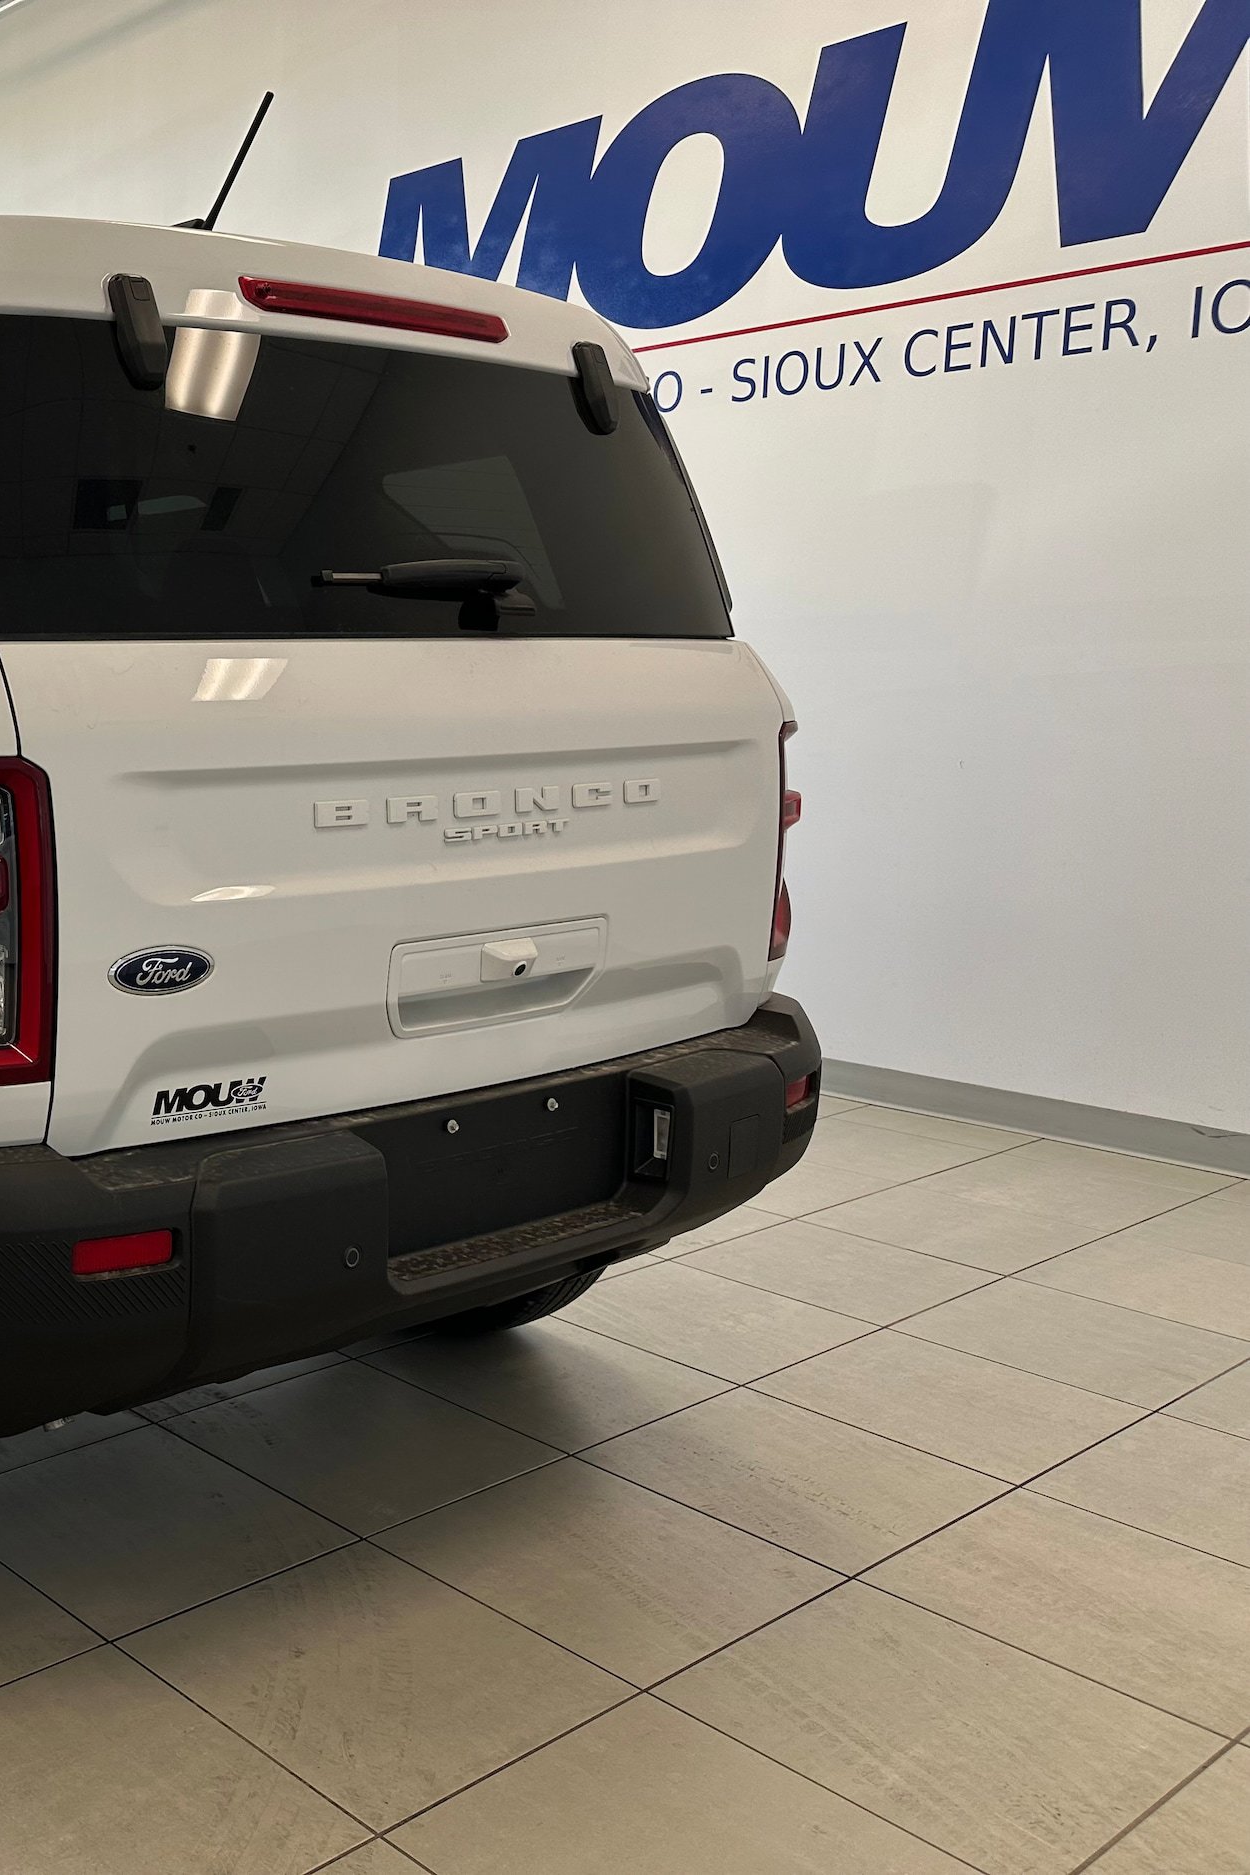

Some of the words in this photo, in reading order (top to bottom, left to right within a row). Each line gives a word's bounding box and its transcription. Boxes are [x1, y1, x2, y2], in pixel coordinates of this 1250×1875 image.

[731, 337, 883, 402] SIOUX
[904, 298, 1158, 378] CENTER,
[314, 778, 661, 828] BRONCO
[444, 818, 570, 843] SPORT
[136, 957, 191, 986] Ford
[150, 1118, 171, 1126] MOUW
[209, 1110, 227, 1118] SIOUX
[228, 1106, 251, 1114] CENTER,
